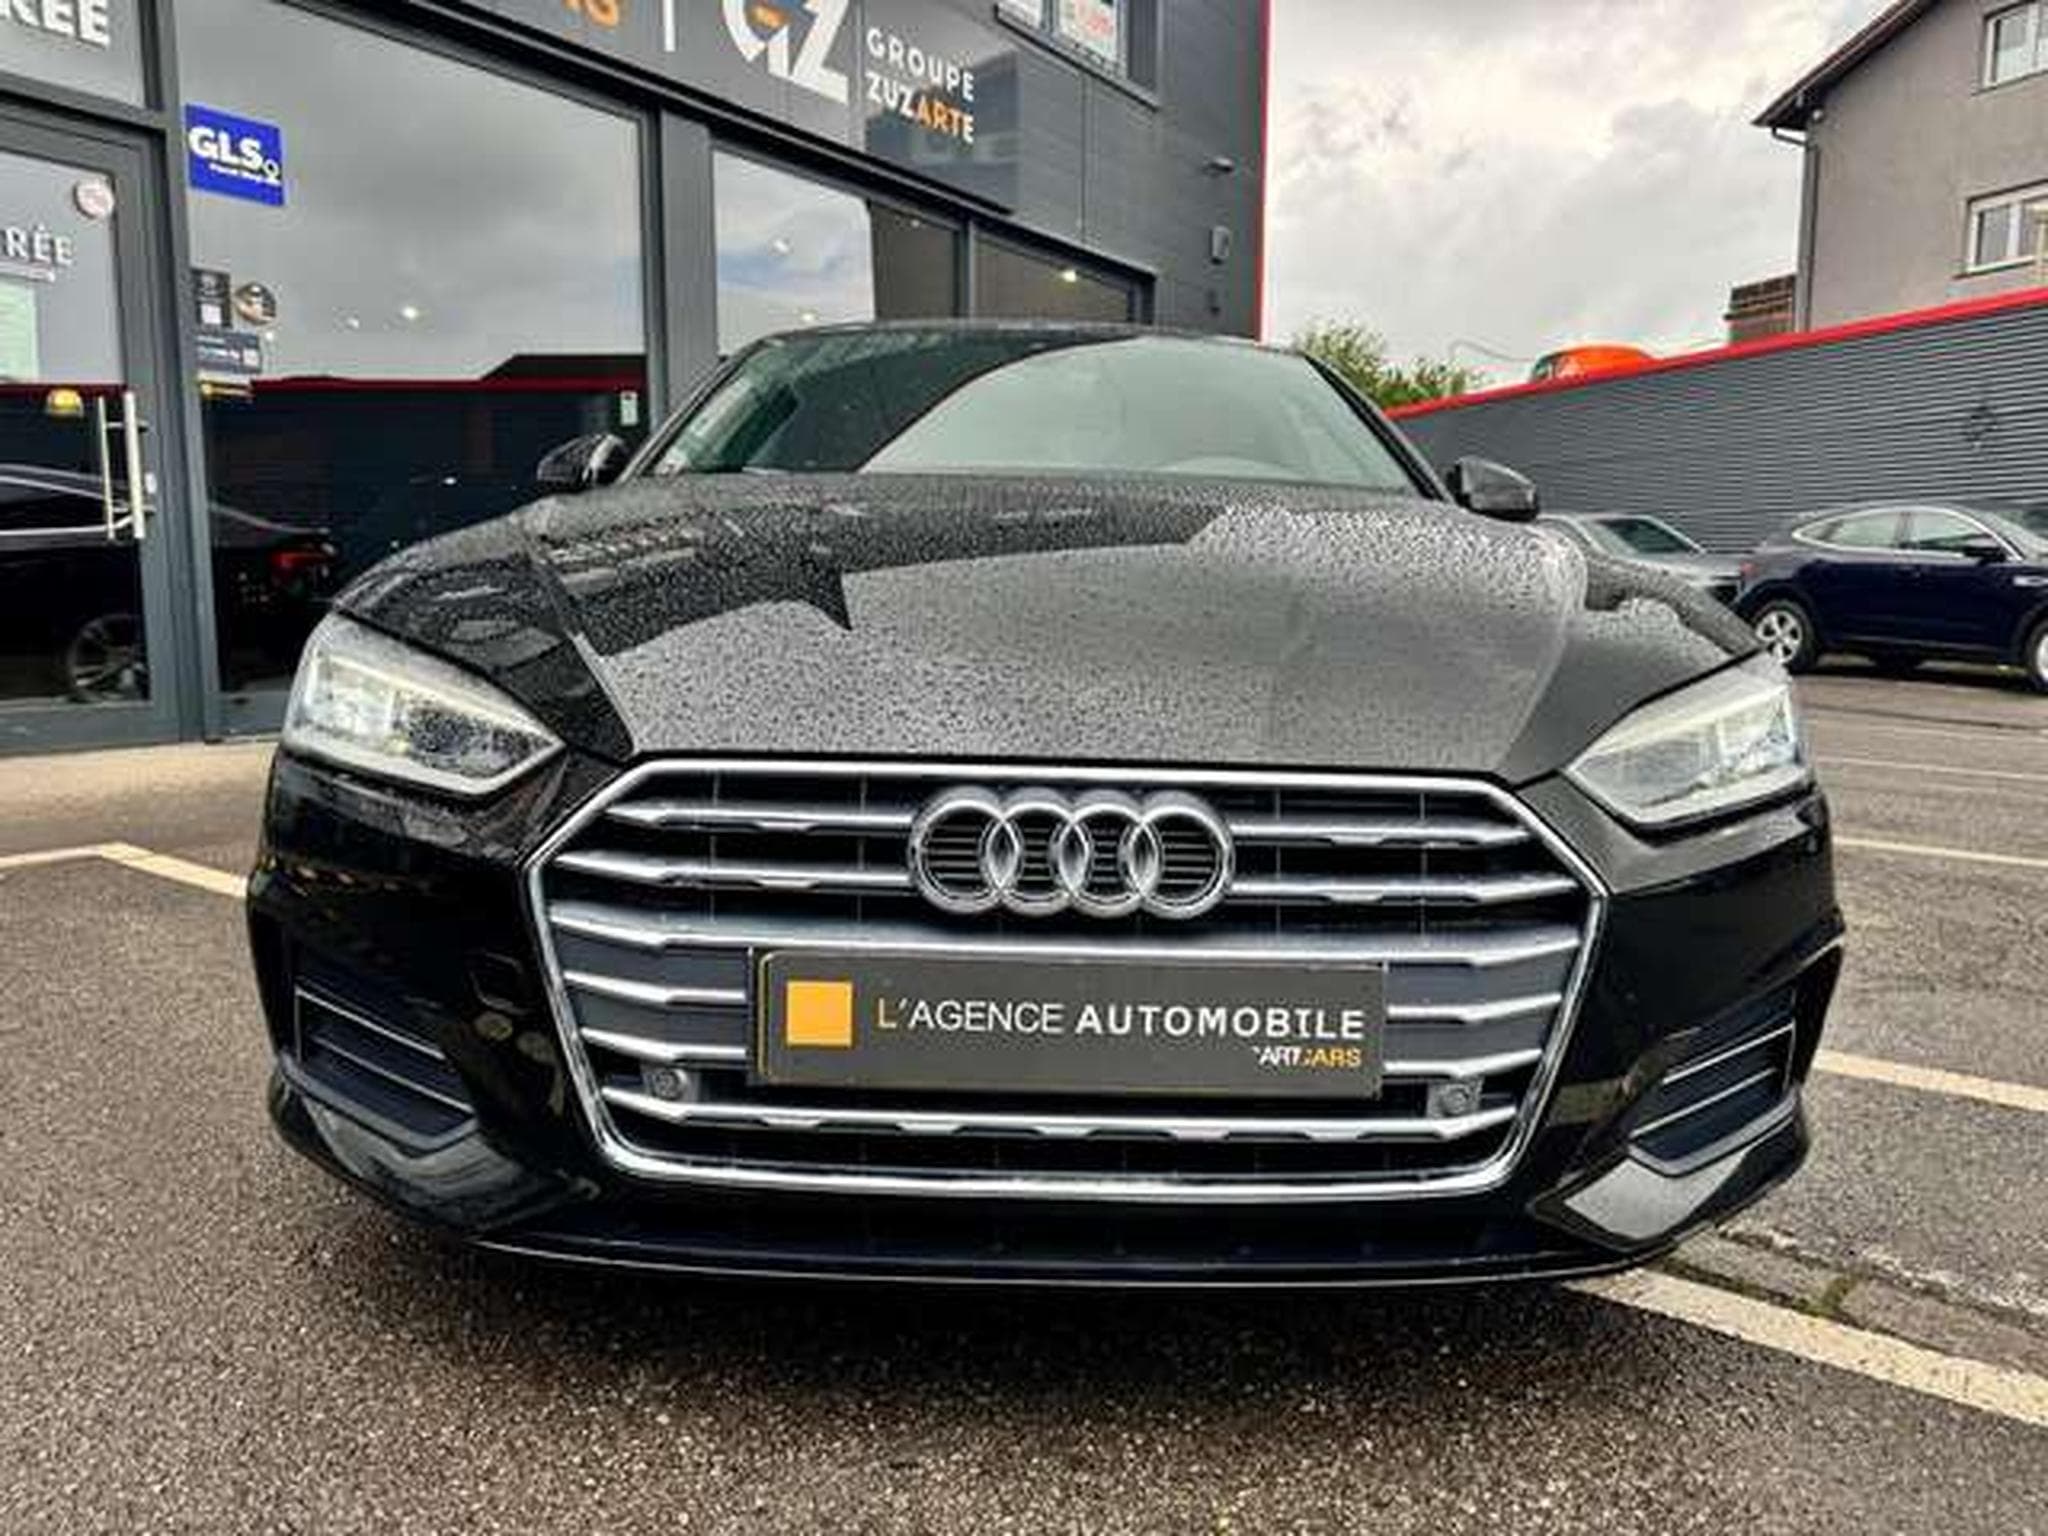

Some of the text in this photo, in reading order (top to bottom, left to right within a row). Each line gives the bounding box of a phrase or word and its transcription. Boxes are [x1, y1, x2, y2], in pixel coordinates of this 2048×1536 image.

[866, 27, 975, 102] GROUPE
[865, 71, 975, 144] ZUZARTE
[877, 997, 1365, 1040] L'AGENCE AUTOMOBILE
